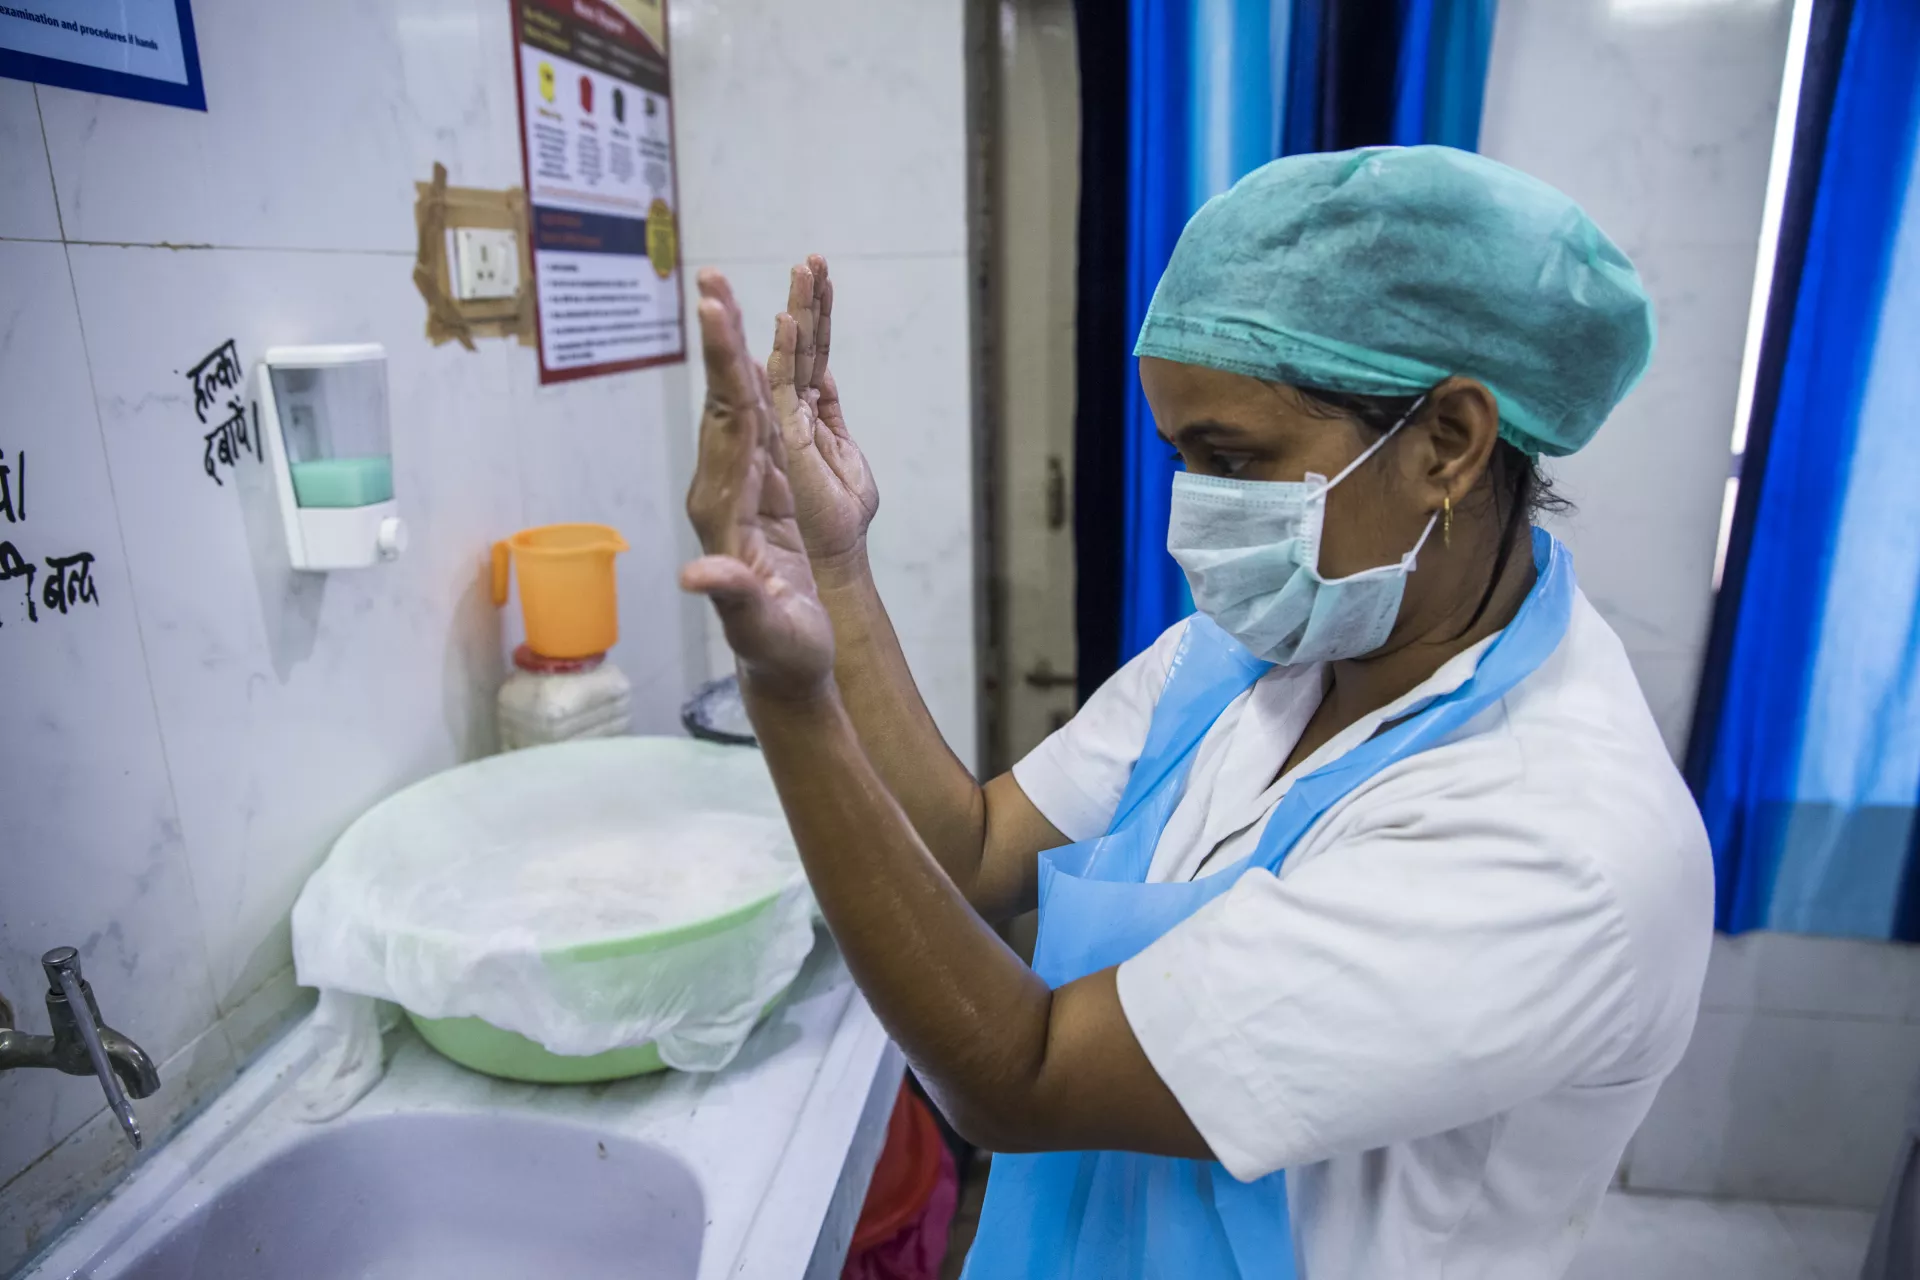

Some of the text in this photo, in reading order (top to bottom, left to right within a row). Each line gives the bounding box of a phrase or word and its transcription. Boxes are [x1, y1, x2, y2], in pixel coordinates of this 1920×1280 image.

[0, 5, 59, 28] examination
[61, 20, 78, 32] and
[80, 25, 127, 43] procedures
[135, 35, 158, 50] hands
